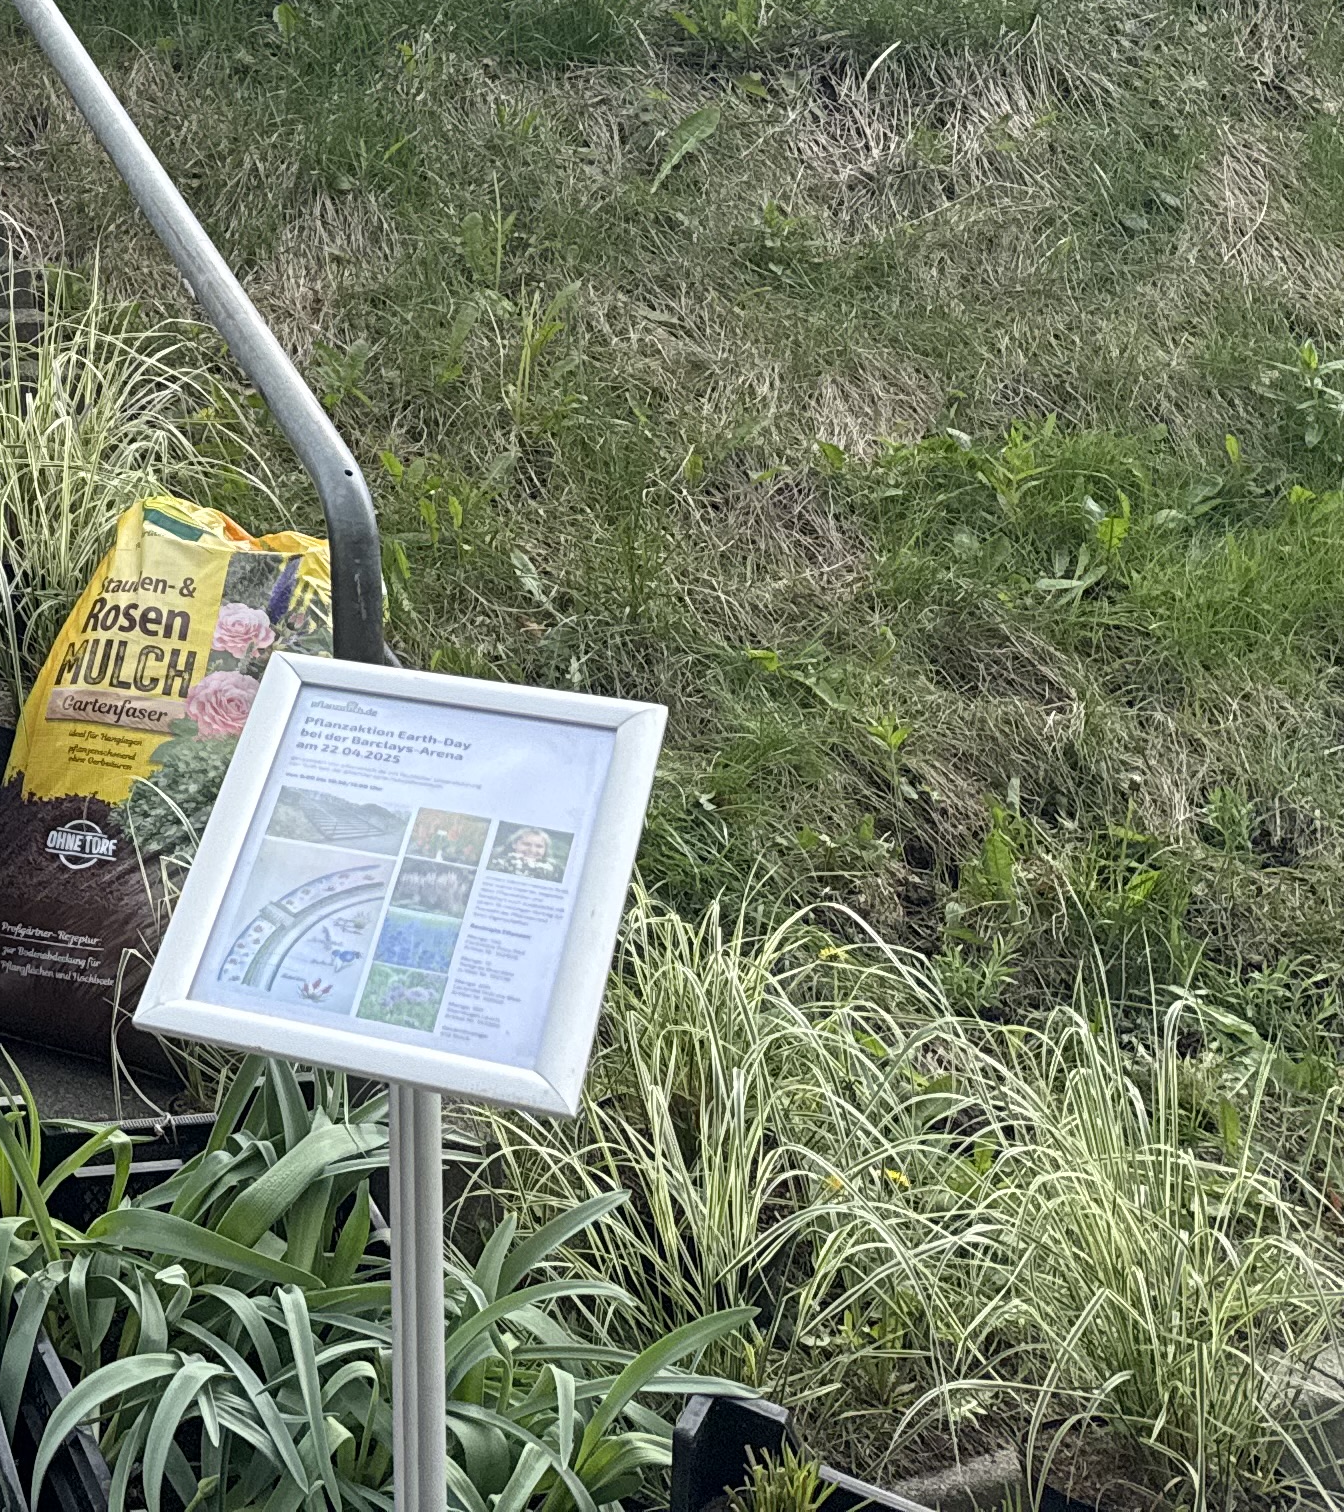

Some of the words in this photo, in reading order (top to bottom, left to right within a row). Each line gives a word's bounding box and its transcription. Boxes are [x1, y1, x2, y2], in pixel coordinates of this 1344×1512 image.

[179, 577, 197, 599] &
[81, 596, 191, 642] Rosen
[54, 638, 198, 699] MULCH
[62, 694, 168, 724] Gartenfaser
[295, 739, 319, 752] am
[300, 727, 322, 740] bei
[324, 732, 350, 744] der
[351, 735, 464, 762] Barclays-Arena
[304, 715, 395, 739] Pflanzaktion
[397, 730, 472, 752] Earth-Day
[46, 830, 82, 852] OHNE
[84, 835, 118, 857] TORF
